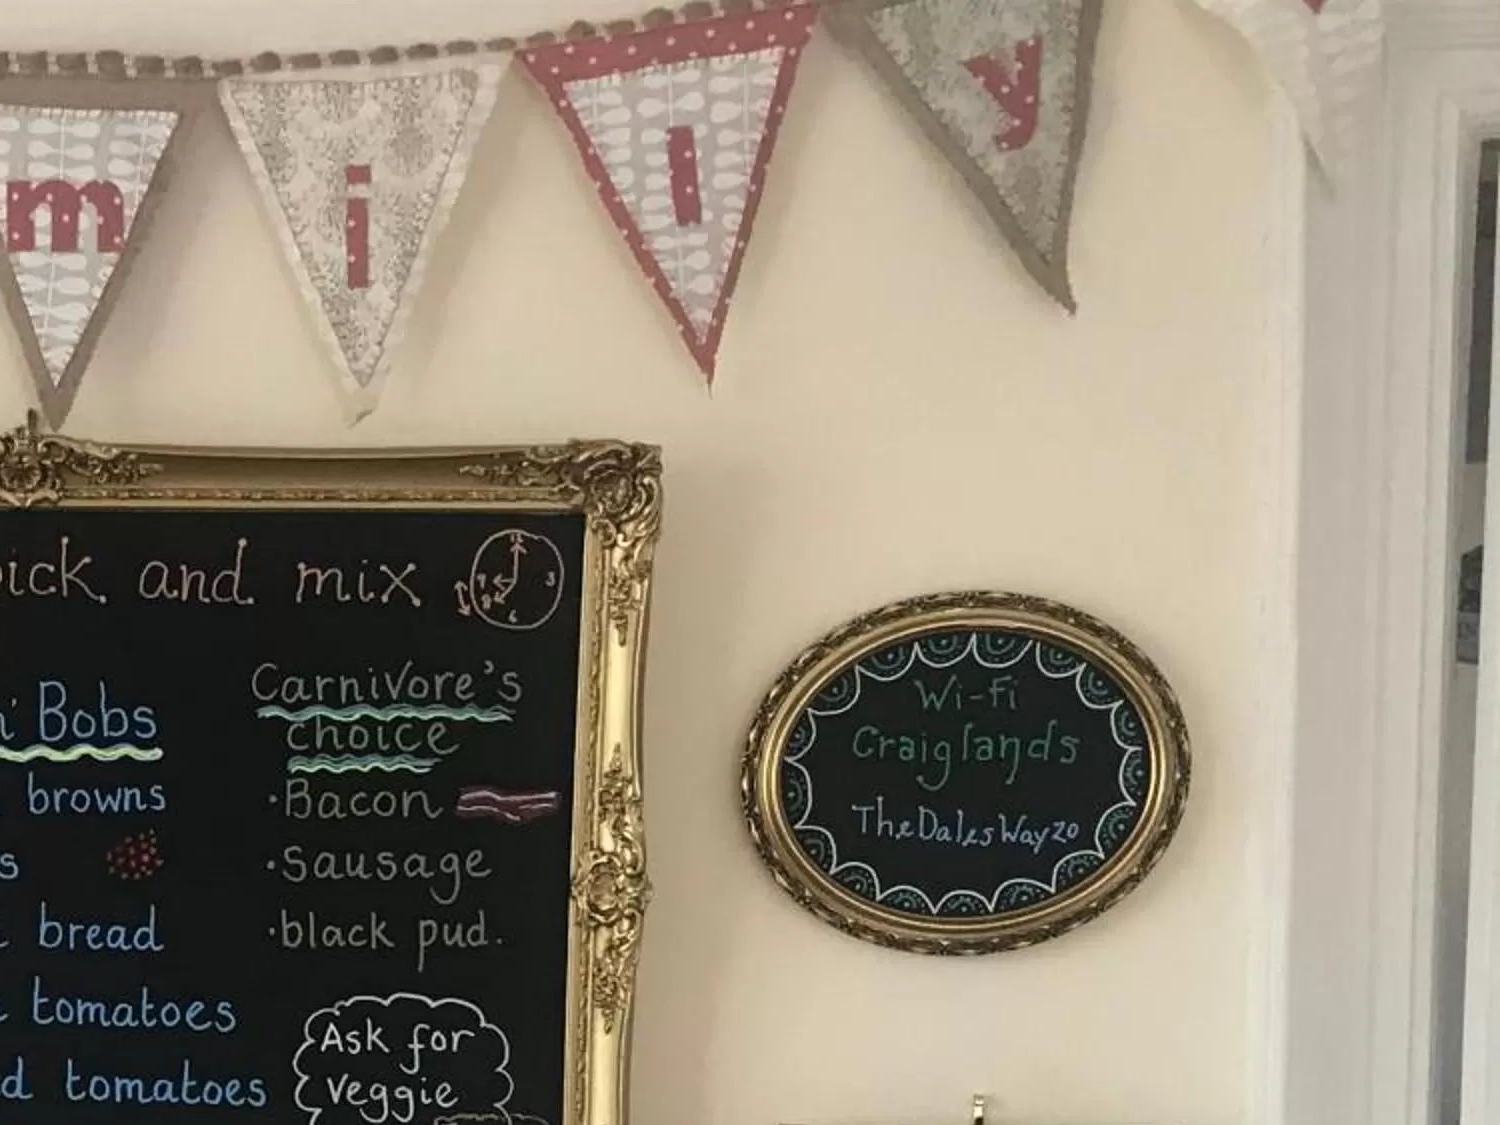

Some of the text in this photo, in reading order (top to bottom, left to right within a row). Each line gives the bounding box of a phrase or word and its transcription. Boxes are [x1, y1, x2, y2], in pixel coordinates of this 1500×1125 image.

[139, 539, 255, 606] and
[296, 562, 421, 607] mix
[39, 680, 157, 743] Bobs
[913, 674, 1019, 711] Wi-Fi
[287, 714, 459, 754] choice
[852, 719, 1081, 791] Craiglands
[28, 771, 166, 815] browns
[285, 778, 443, 819] Bacon
[39, 901, 164, 952] bread
[281, 908, 502, 973] black pud.
[33, 976, 237, 1032] tomatoes
[321, 1017, 475, 1075] Ask for
[66, 1058, 267, 1107] tomatoes
[327, 1073, 458, 1123] Veggie
